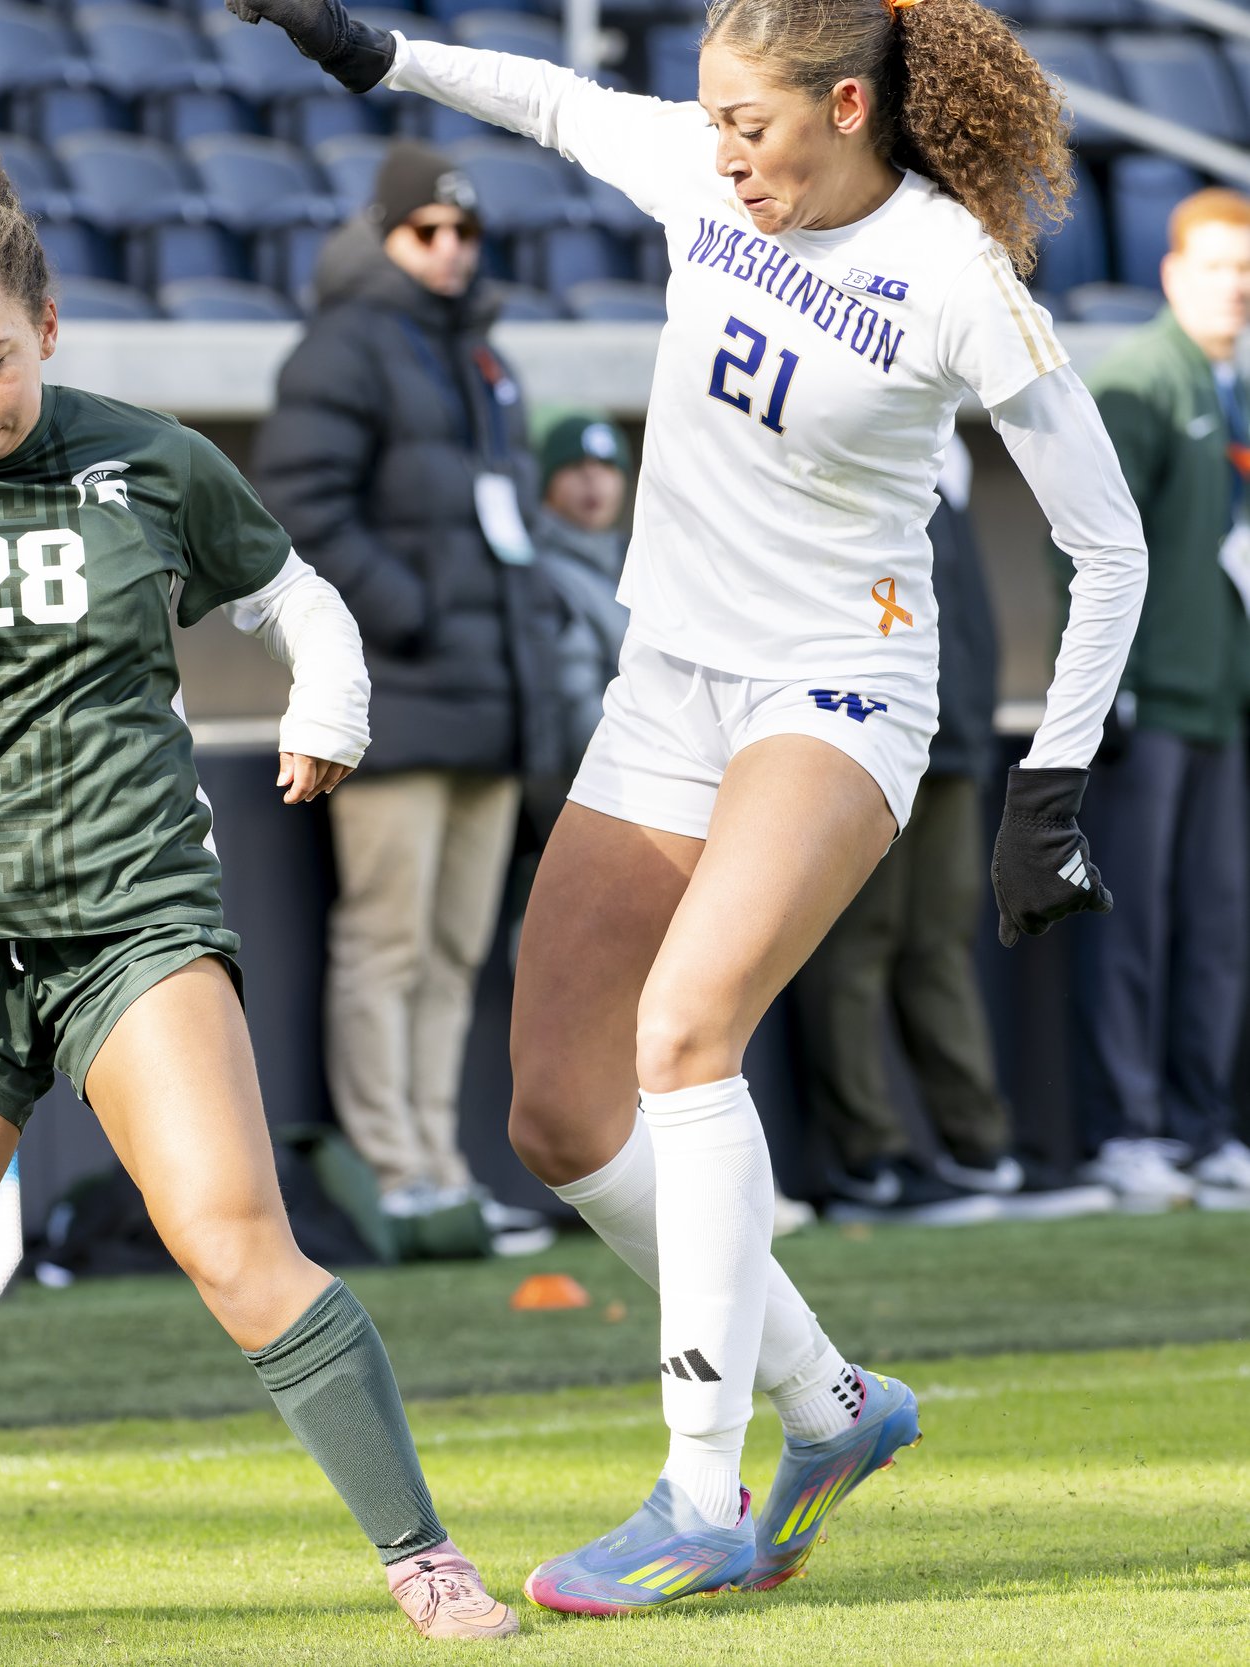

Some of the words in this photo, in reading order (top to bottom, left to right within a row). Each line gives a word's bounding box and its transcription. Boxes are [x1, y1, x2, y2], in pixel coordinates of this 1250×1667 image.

[687, 217, 905, 375] WASHINGTON
[706, 313, 800, 437] 21
[808, 688, 888, 724] W
[670, 1544, 728, 1565] F50
